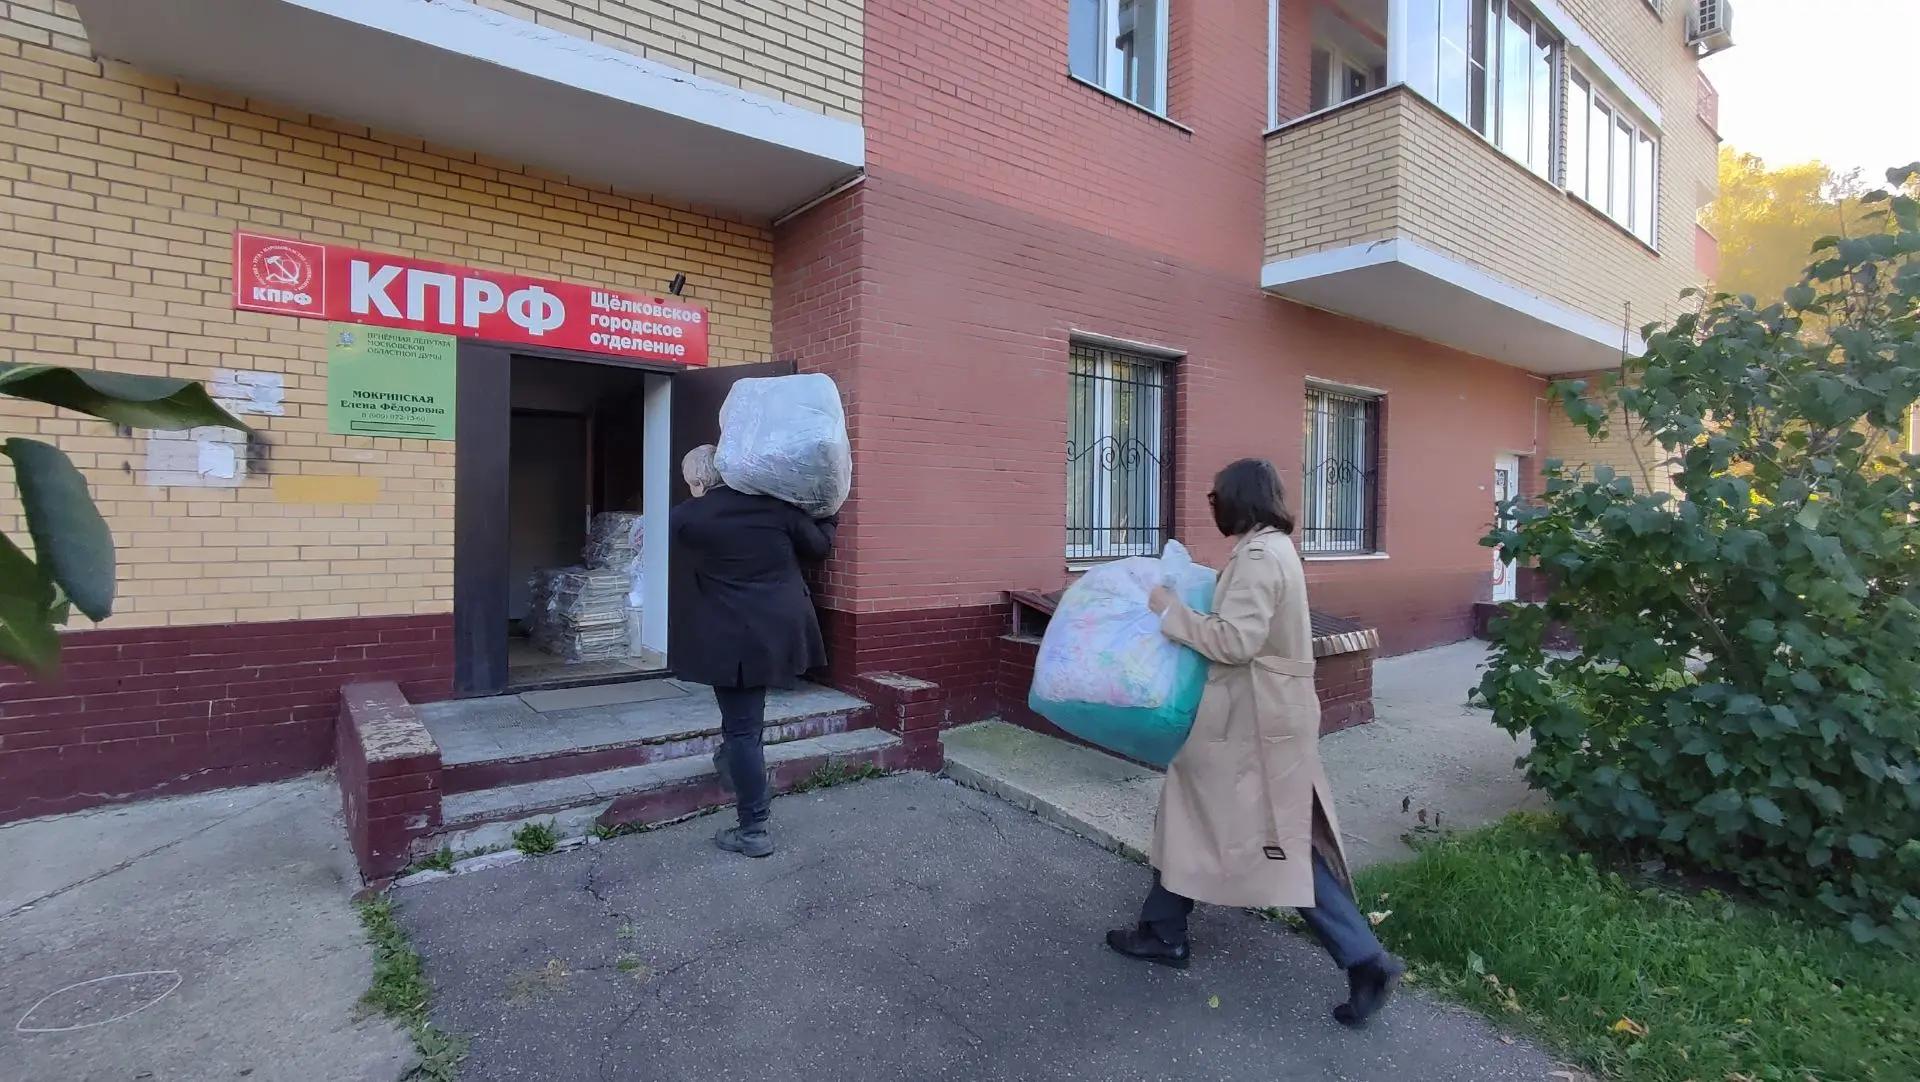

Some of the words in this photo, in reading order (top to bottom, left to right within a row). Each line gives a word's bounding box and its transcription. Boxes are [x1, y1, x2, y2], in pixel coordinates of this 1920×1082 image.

[253, 287, 312, 306] КПРФ
[350, 259, 565, 336] КПРФ
[590, 291, 702, 323] Щёлковское
[590, 314, 683, 338] городское
[590, 332, 685, 356] отделение
[340, 400, 376, 410] Елена
[380, 402, 445, 415] Фёдоровна
